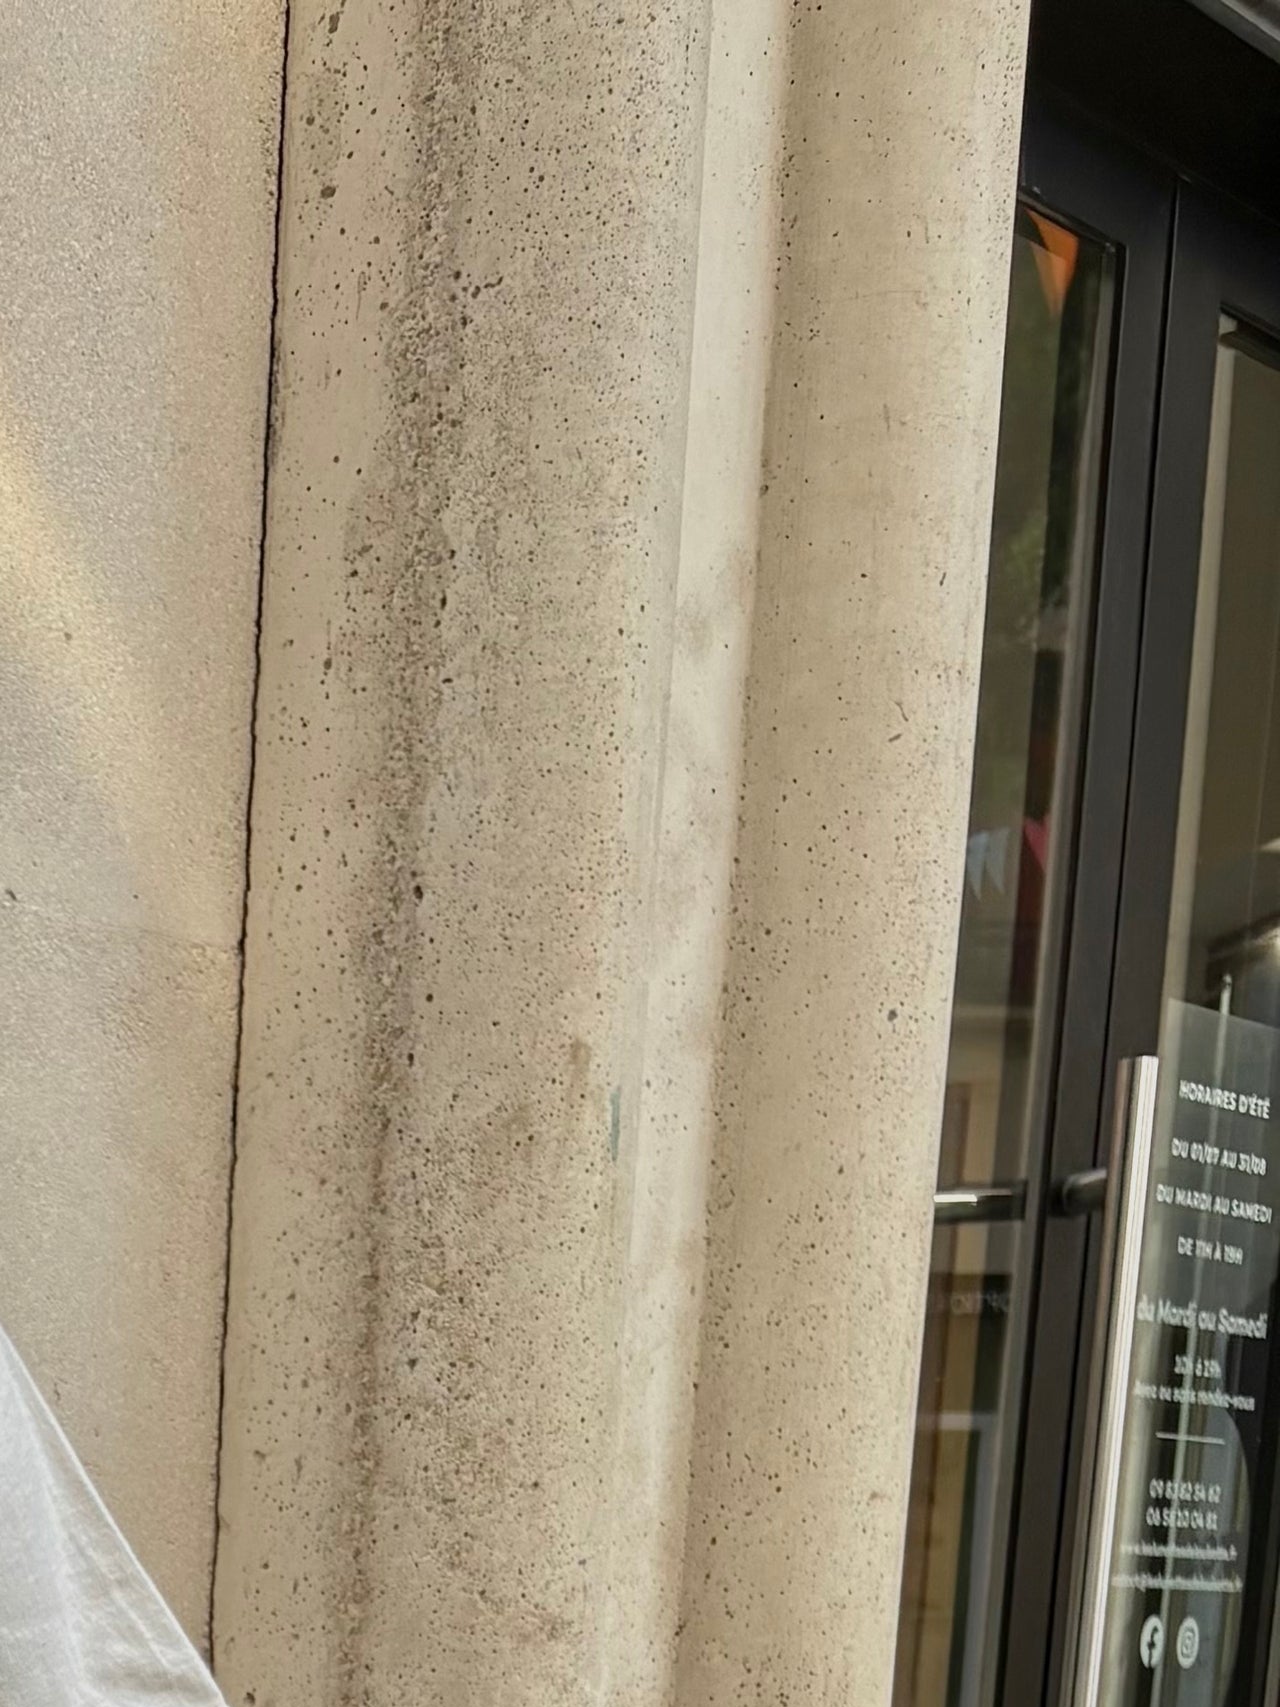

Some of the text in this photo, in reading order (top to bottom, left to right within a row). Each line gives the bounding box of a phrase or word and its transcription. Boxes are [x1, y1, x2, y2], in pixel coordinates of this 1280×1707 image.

[1178, 1080, 1237, 1112] HORAIRES
[1172, 1138, 1189, 1158] DU
[1220, 1150, 1237, 1170] AU
[1156, 1184, 1272, 1224] DU MARDI AU SAMEDI
[1178, 1236, 1193, 1256] DE
[1136, 1294, 1154, 1322] du
[1156, 1298, 1197, 1328] Mardi
[1218, 1308, 1268, 1339] Samedi
